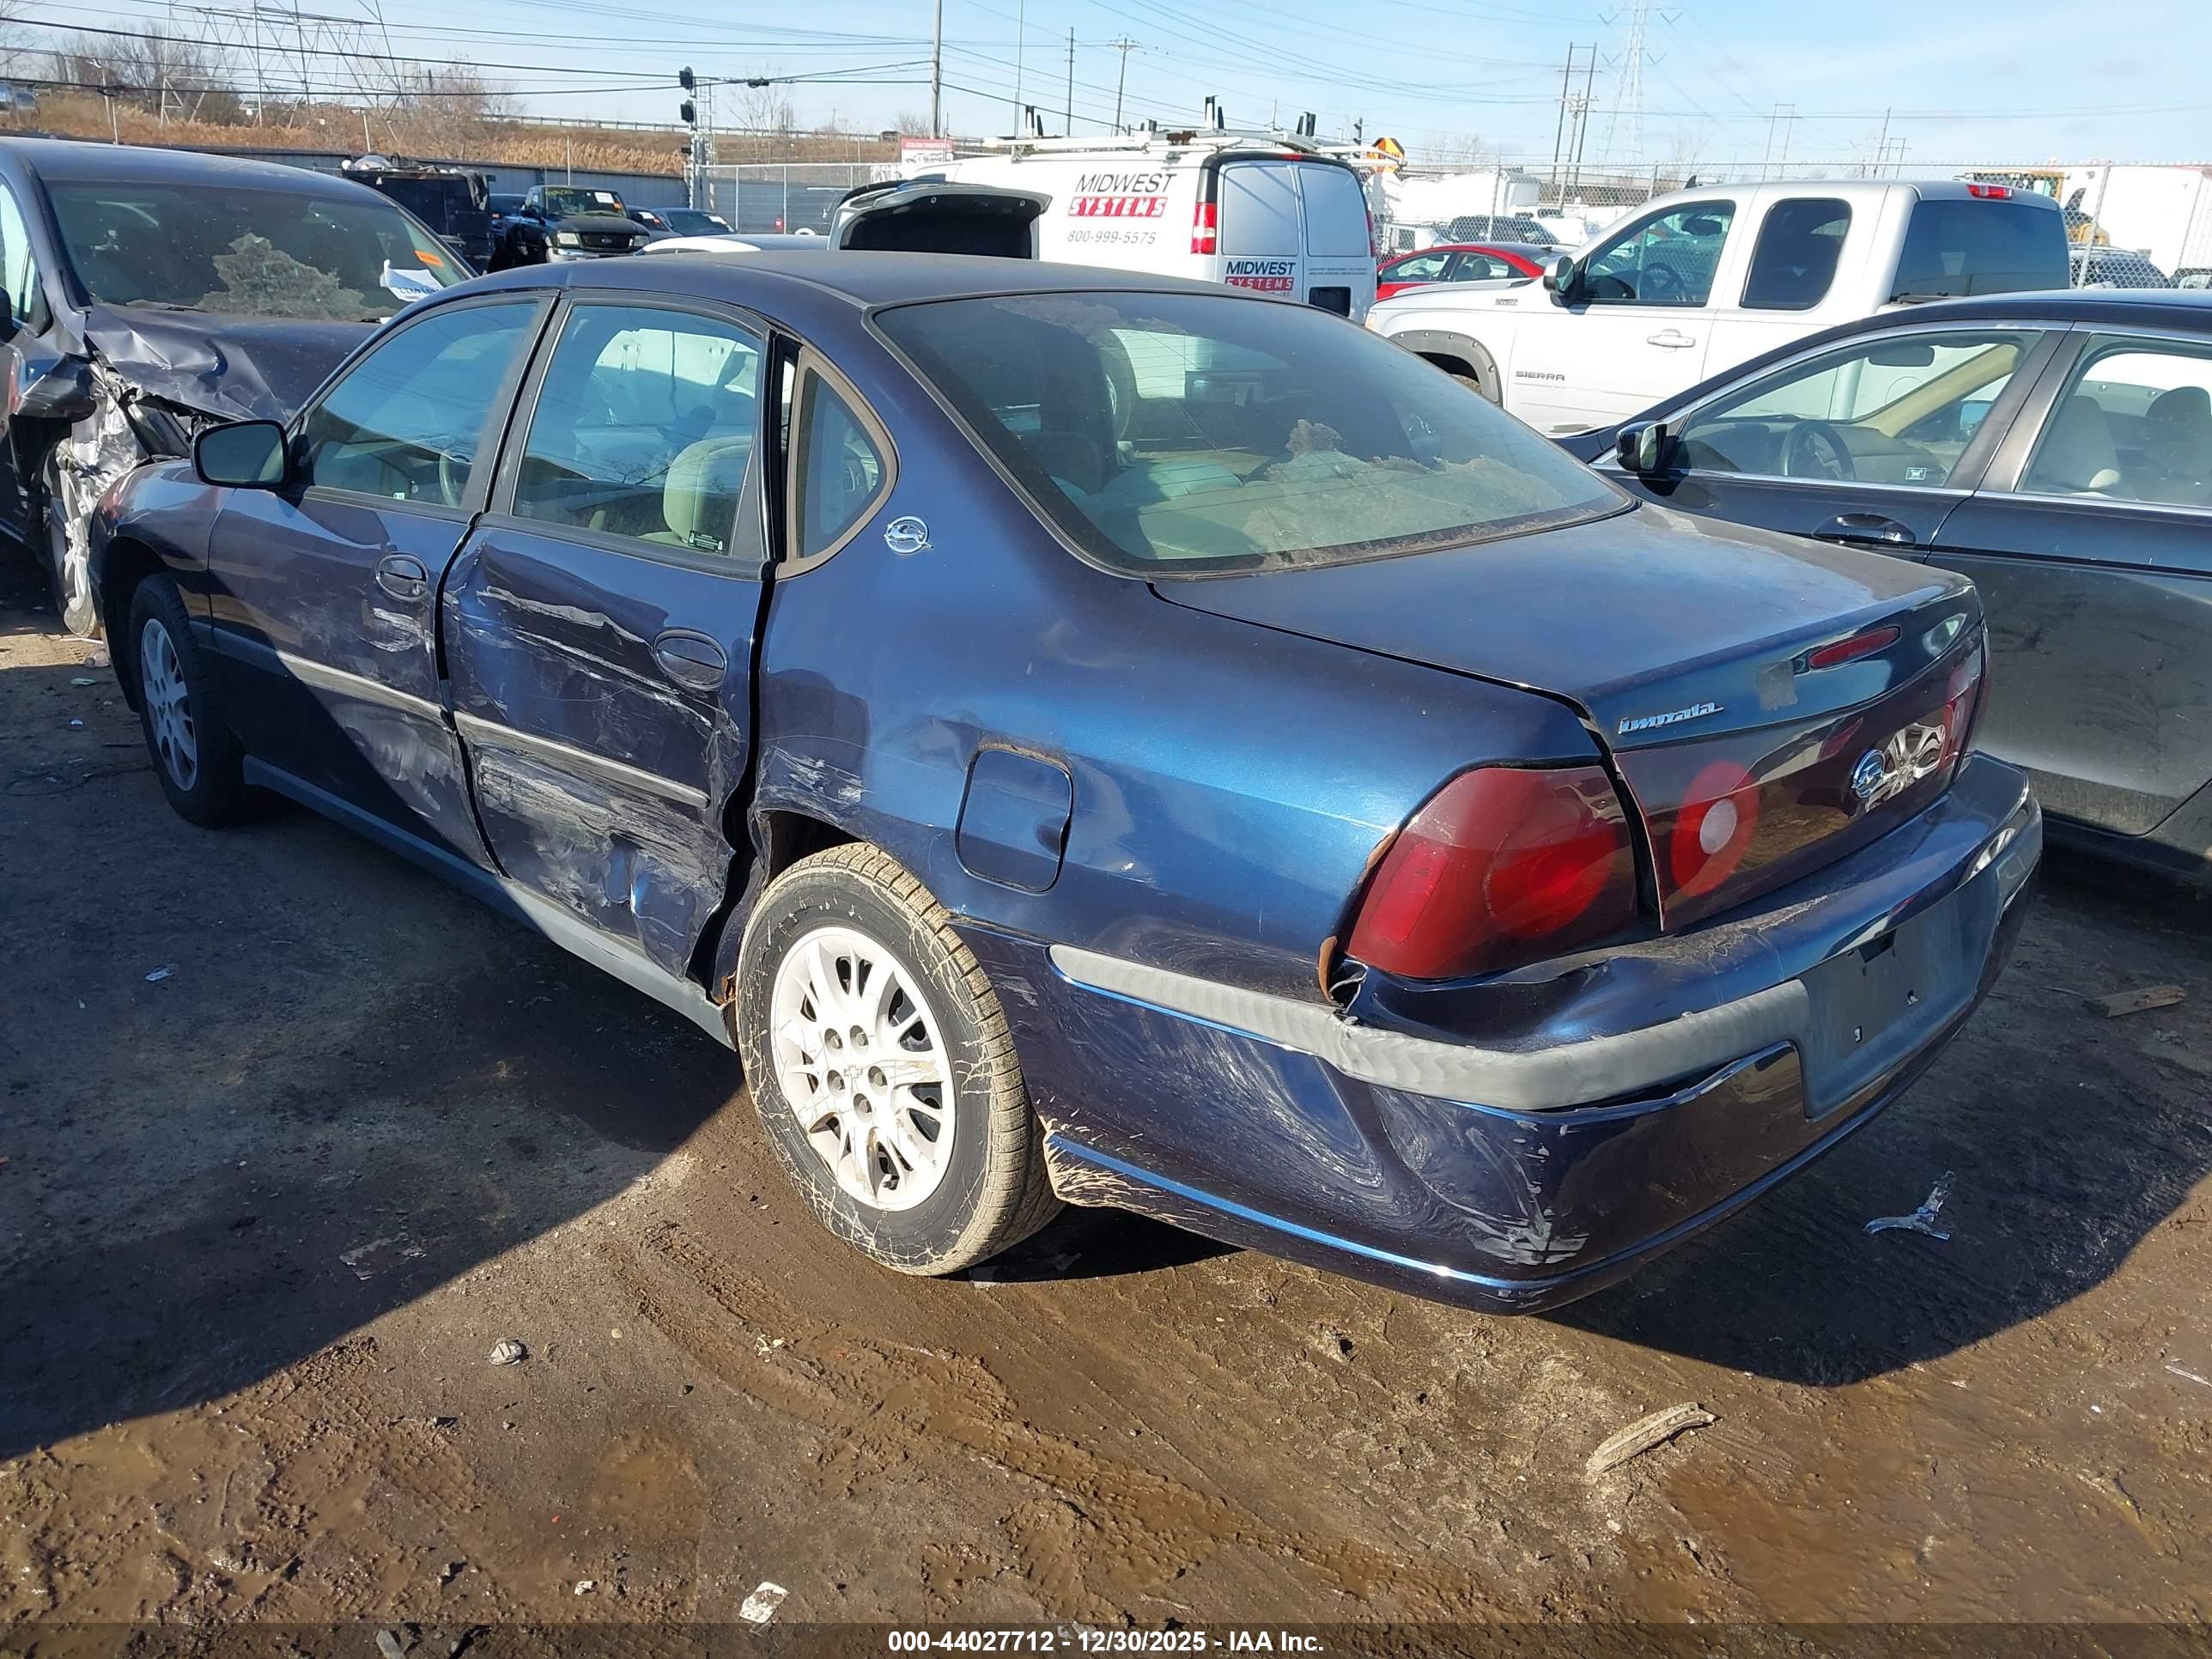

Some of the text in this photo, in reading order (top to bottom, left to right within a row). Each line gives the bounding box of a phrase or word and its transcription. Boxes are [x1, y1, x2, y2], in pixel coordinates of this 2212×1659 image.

[1075, 173, 1177, 193] MIDWEST
[1069, 197, 1166, 216] SYSTEMS
[1067, 230, 1157, 245] 800-999-5575
[1226, 261, 1296, 276] MIDWEST
[1226, 277, 1293, 289] SYSTEMS
[1516, 371, 1565, 381] SIERRA
